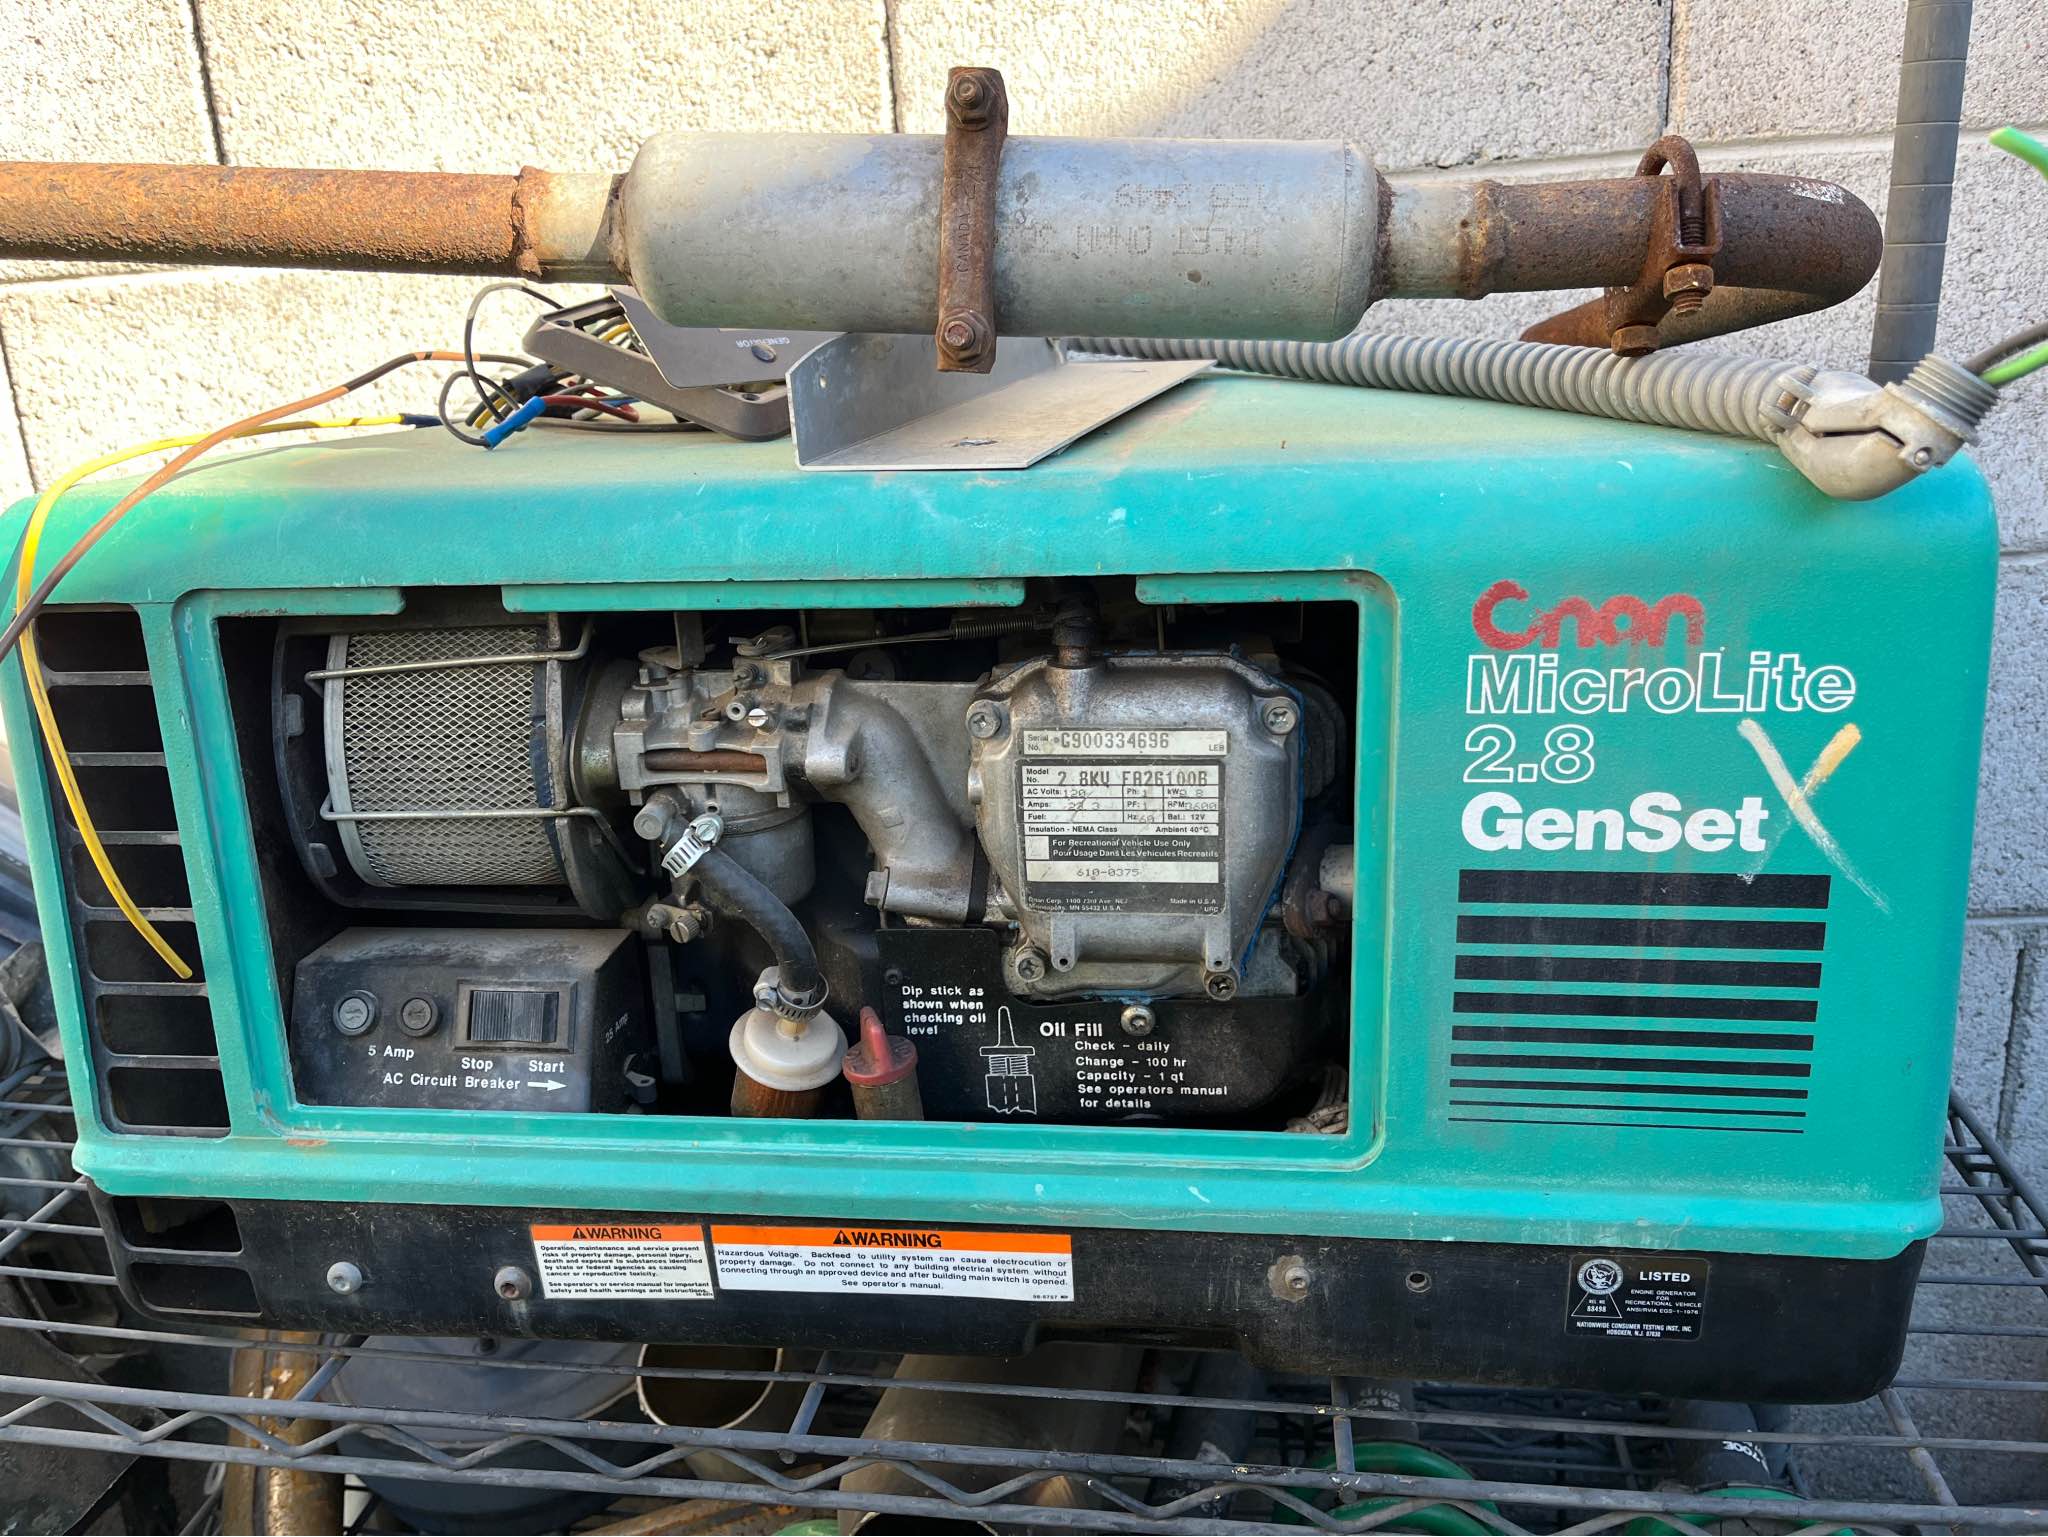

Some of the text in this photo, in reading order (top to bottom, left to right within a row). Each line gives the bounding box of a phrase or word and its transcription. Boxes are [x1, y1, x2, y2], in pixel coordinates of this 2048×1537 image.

[1466, 651, 1857, 715] MicroLite
[1027, 734, 1049, 742] Serial
[1462, 724, 1595, 784] 2.8
[1461, 791, 1769, 853] GenSet
[1068, 839, 1119, 847] Recreational
[1120, 839, 1151, 847] Vehicle
[1171, 839, 1190, 848] Only
[1052, 848, 1071, 856] Pour
[1073, 849, 1098, 857] Usage
[902, 985, 984, 997] Dip stick as
[902, 999, 983, 1009] shown when
[904, 1012, 986, 1026] checking oil
[906, 1024, 937, 1034] level
[1039, 1022, 1102, 1036] Oil Fill
[368, 1045, 414, 1061] 5 Amp
[1074, 1040, 1169, 1053] Check daily
[461, 1057, 493, 1072] Stop
[528, 1059, 564, 1072] Start
[1075, 1056, 1186, 1068] Change 100 hr
[382, 1072, 520, 1089] AC Circuit Breaker
[1076, 1070, 1183, 1085] Capacity qt
[1077, 1084, 1227, 1095] See operators manual
[1079, 1098, 1151, 1108] for details
[587, 1227, 662, 1240] WARNING
[851, 1231, 942, 1248] WARNING
[767, 1250, 802, 1259] Voltage.
[811, 1251, 851, 1259] Backfeed
[870, 1253, 895, 1261] utility
[901, 1255, 933, 1263] system
[992, 1258, 1051, 1266] electrocution
[719, 1258, 755, 1266] property
[759, 1259, 795, 1267] damage.
[840, 1261, 875, 1269] connect
[893, 1263, 909, 1271] any
[914, 1264, 949, 1273] building
[952, 1265, 992, 1273] electrical
[996, 1267, 1028, 1275] system
[1033, 1269, 1067, 1277] without
[720, 1266, 767, 1275] connecting
[769, 1267, 803, 1276] through
[818, 1269, 858, 1277] approved
[932, 1273, 966, 1281] building
[1031, 1277, 1067, 1286] opened.
[1639, 1271, 1690, 1282] LISTED
